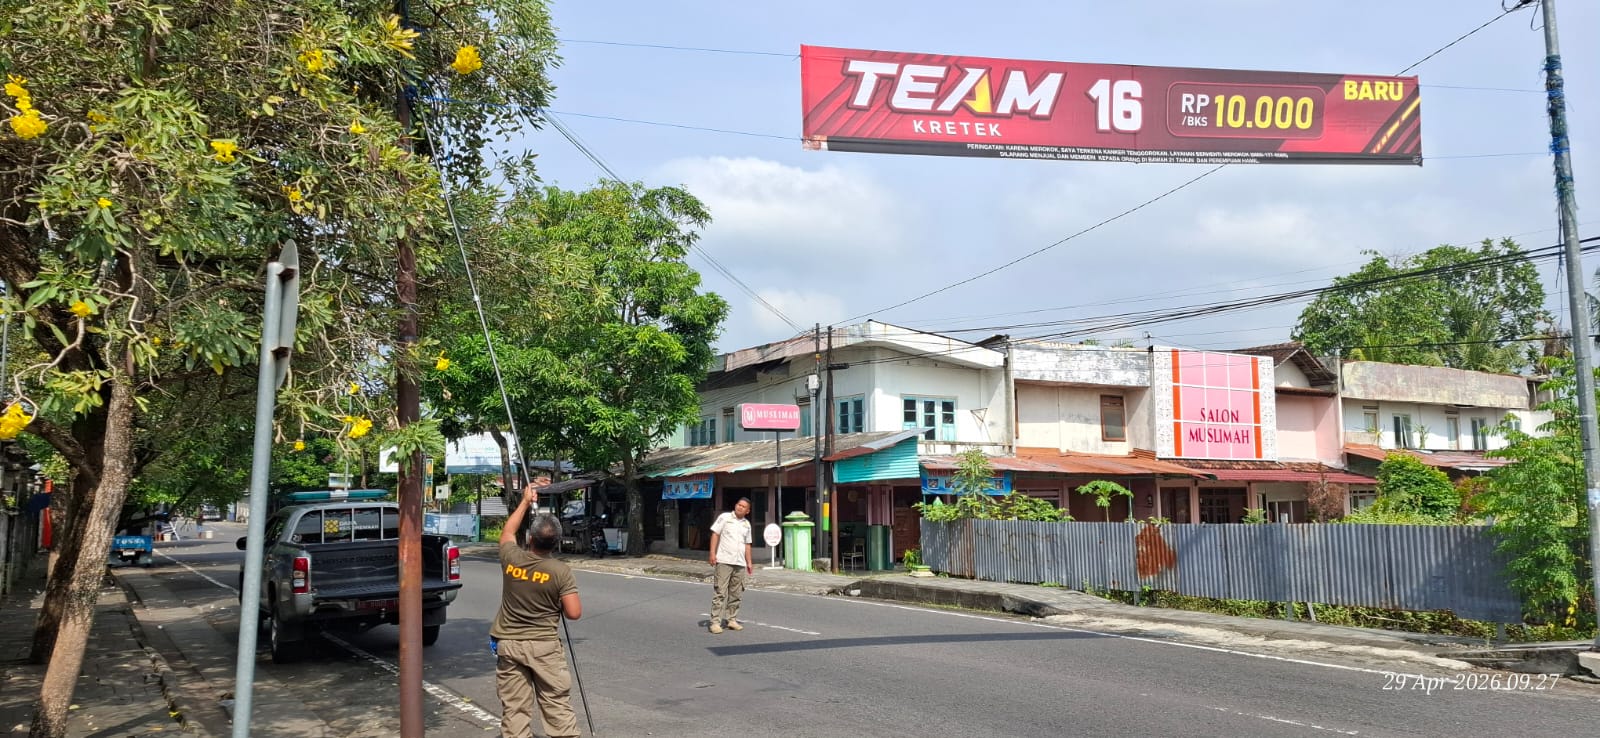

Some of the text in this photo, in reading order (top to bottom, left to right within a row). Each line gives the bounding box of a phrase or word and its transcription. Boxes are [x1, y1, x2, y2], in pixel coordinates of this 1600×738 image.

[846, 59, 1065, 117] TEAM
[1343, 80, 1404, 102] BARU
[1087, 79, 1143, 132] 16
[1181, 93, 1210, 114] RP
[1213, 94, 1315, 130] 10.000
[912, 119, 1003, 138] KRETEK
[1181, 115, 1208, 128] /BKS
[1005, 144, 1029, 152] KARENA
[756, 409, 799, 420] MUSLIMAH
[1200, 407, 1240, 424] SALON
[1188, 427, 1250, 445] MUSLIMAH
[505, 563, 551, 585] POL PP
